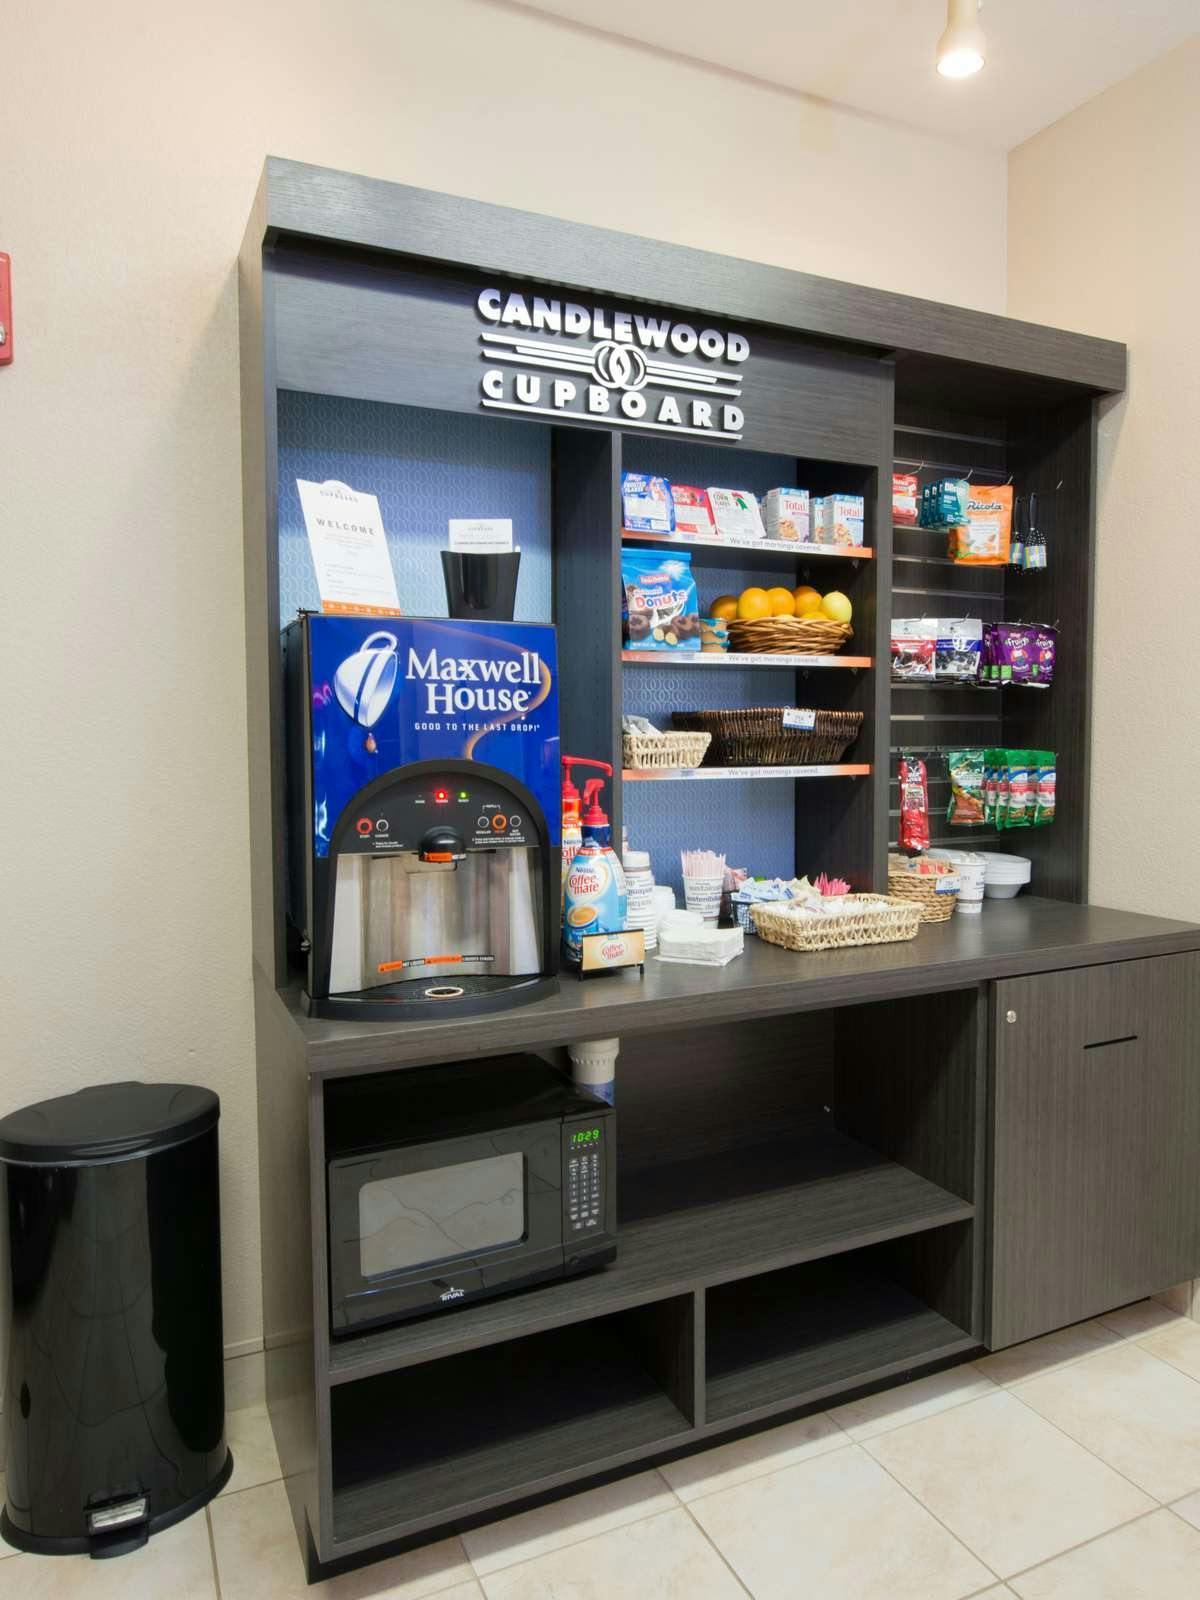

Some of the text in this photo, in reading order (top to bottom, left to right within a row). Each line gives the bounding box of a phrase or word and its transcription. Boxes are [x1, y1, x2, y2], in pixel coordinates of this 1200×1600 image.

[477, 288, 750, 363] CANDLEWOOD
[481, 369, 745, 432] CUPBOARD
[784, 500, 806, 511] Total
[839, 507, 860, 517] Total
[967, 501, 1002, 510] Ricola
[316, 518, 375, 535] WELCOME
[635, 589, 687, 609] Donuts
[405, 647, 542, 685] Maxwell
[425, 683, 530, 714] House
[414, 722, 441, 731] GOOD
[446, 722, 458, 731] TO
[462, 723, 479, 731] THE
[484, 723, 507, 731] LAST
[569, 873, 598, 886] Coffee
[574, 882, 599, 895] mate
[602, 942, 624, 956] Coffee
[573, 1129, 599, 1143] 1029
